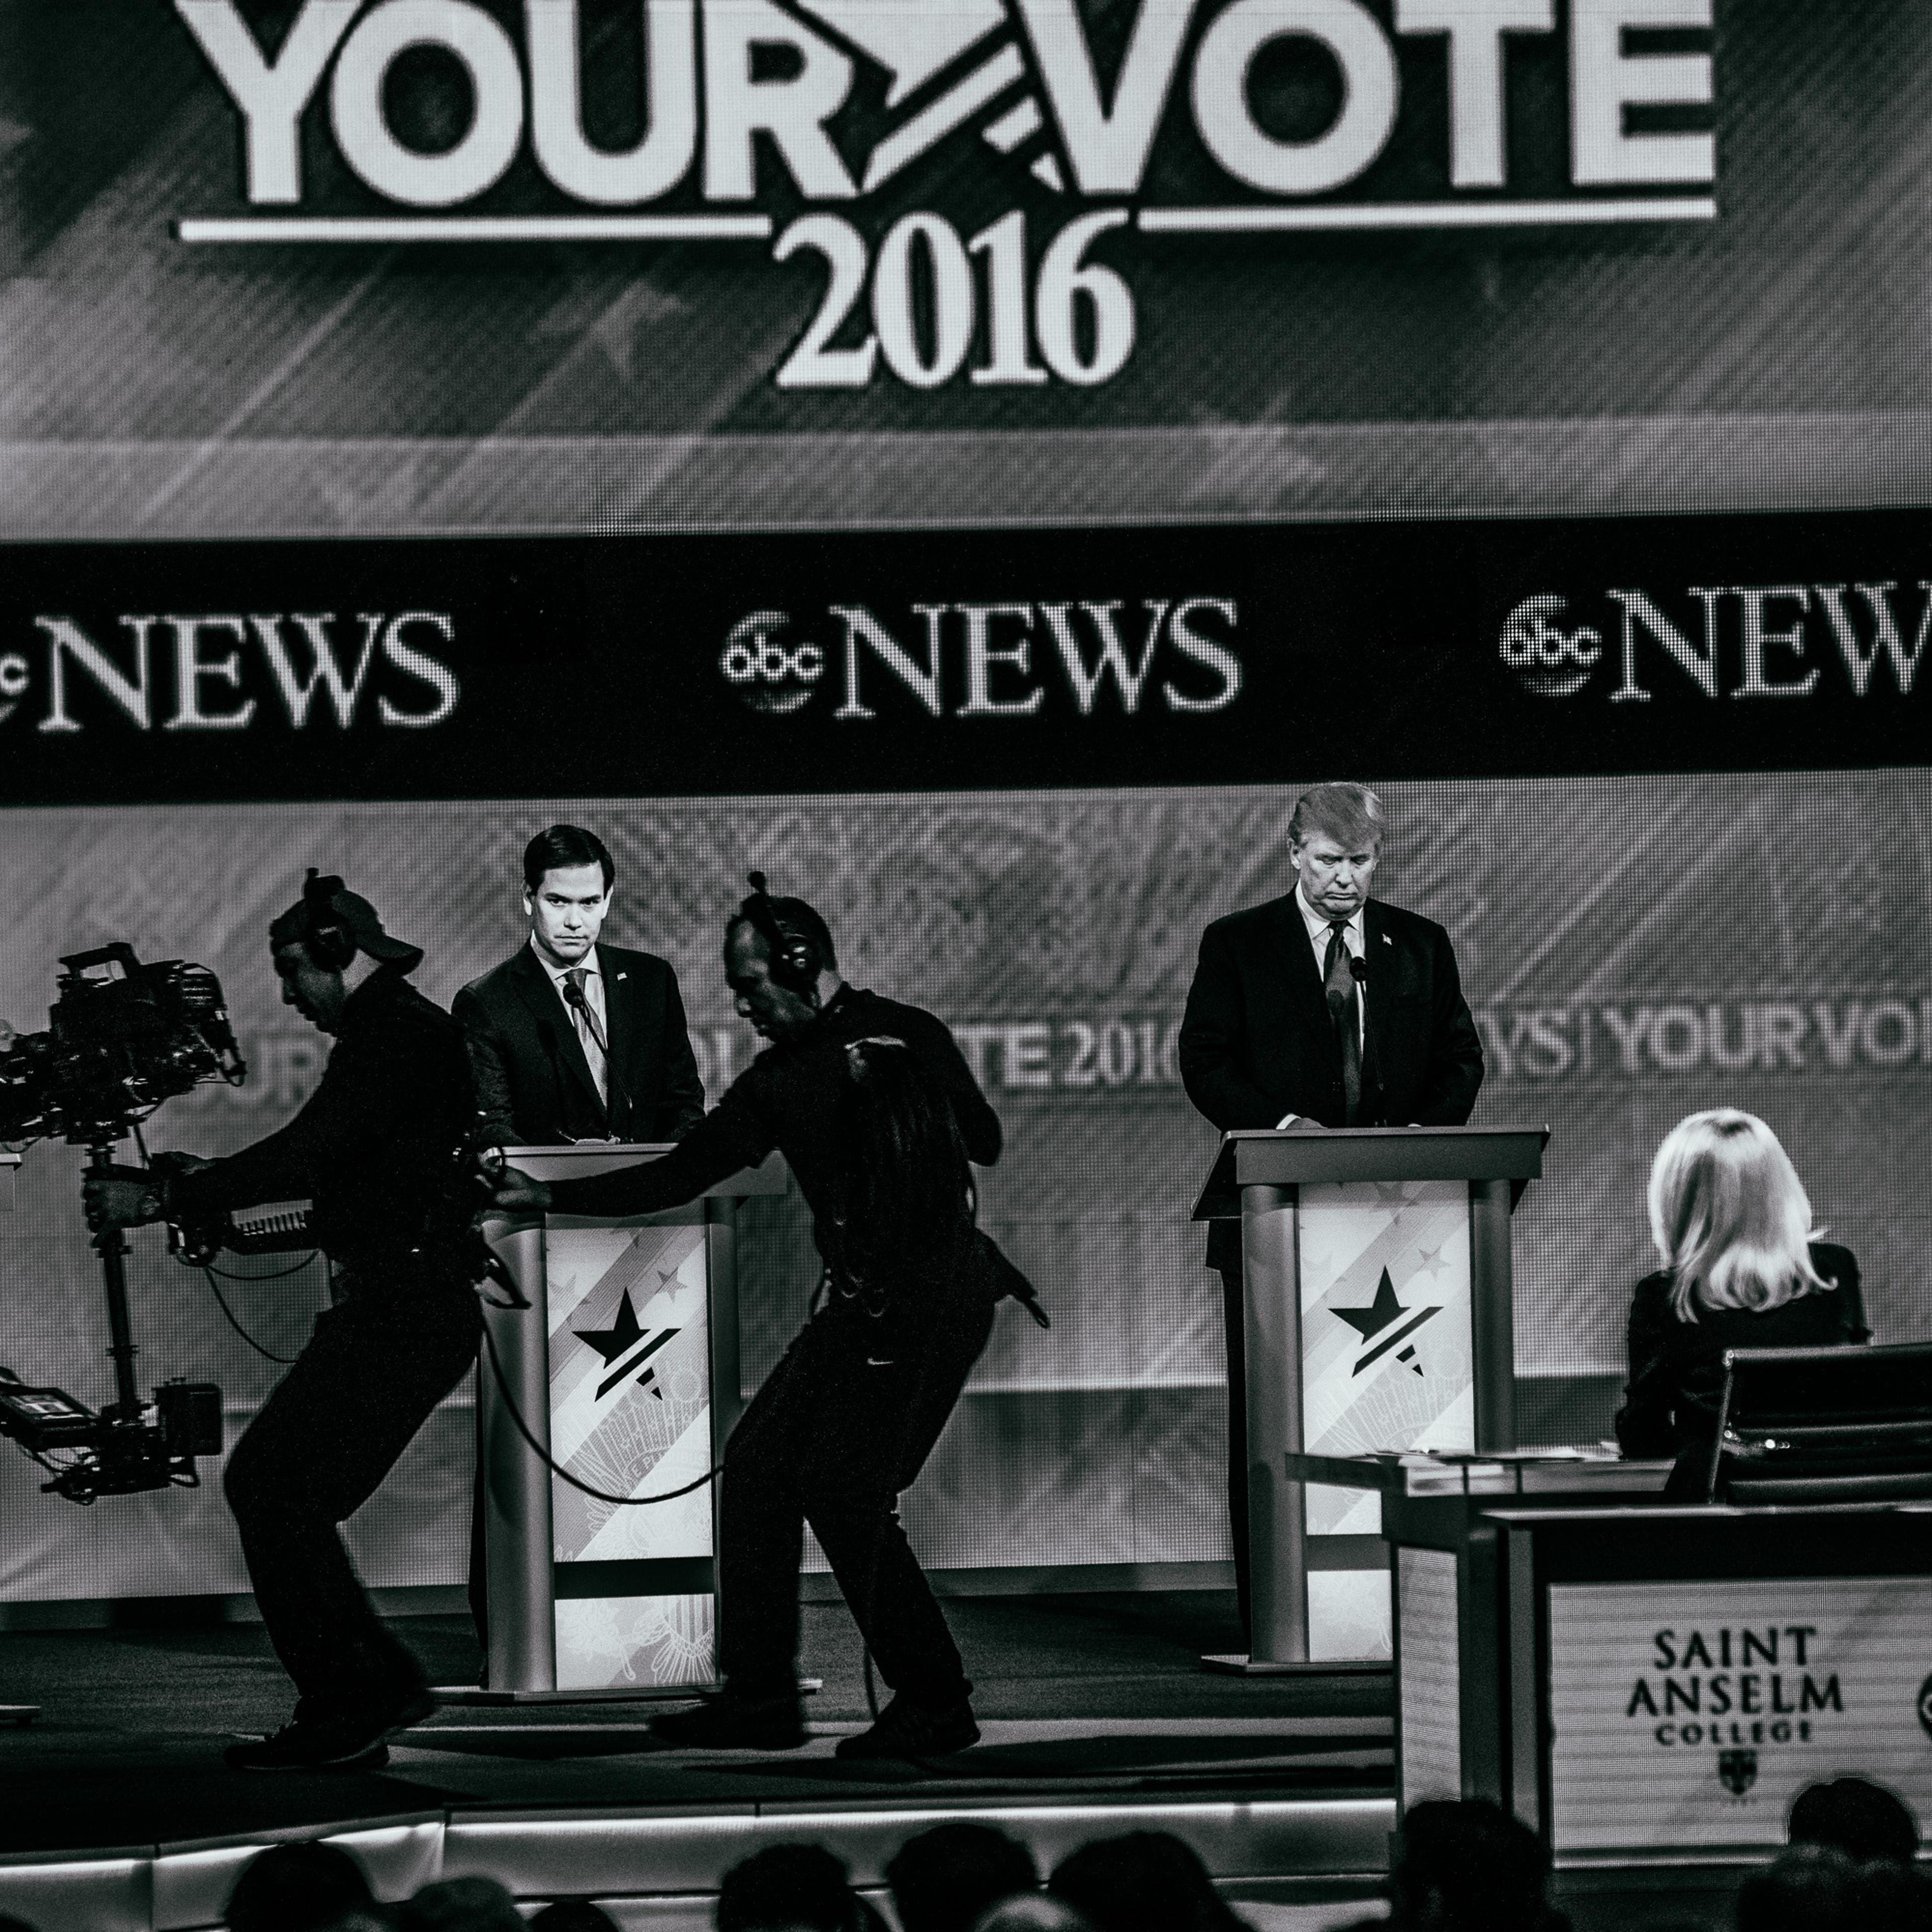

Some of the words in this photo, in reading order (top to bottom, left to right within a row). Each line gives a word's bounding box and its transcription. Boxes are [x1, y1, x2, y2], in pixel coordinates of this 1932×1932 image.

[176, 0, 859, 205] YOUR
[1018, 0, 1716, 194] VOTE
[772, 209, 1136, 388] 2016
[34, 611, 460, 733] NEWS
[828, 597, 1242, 719] NEWS
[1602, 1003, 1807, 1072] YOUR
[1626, 1673, 1845, 1717] ANSELM
[1653, 1625, 1817, 1670] SAINT
[1654, 1720, 1812, 1746] COLLEGE
